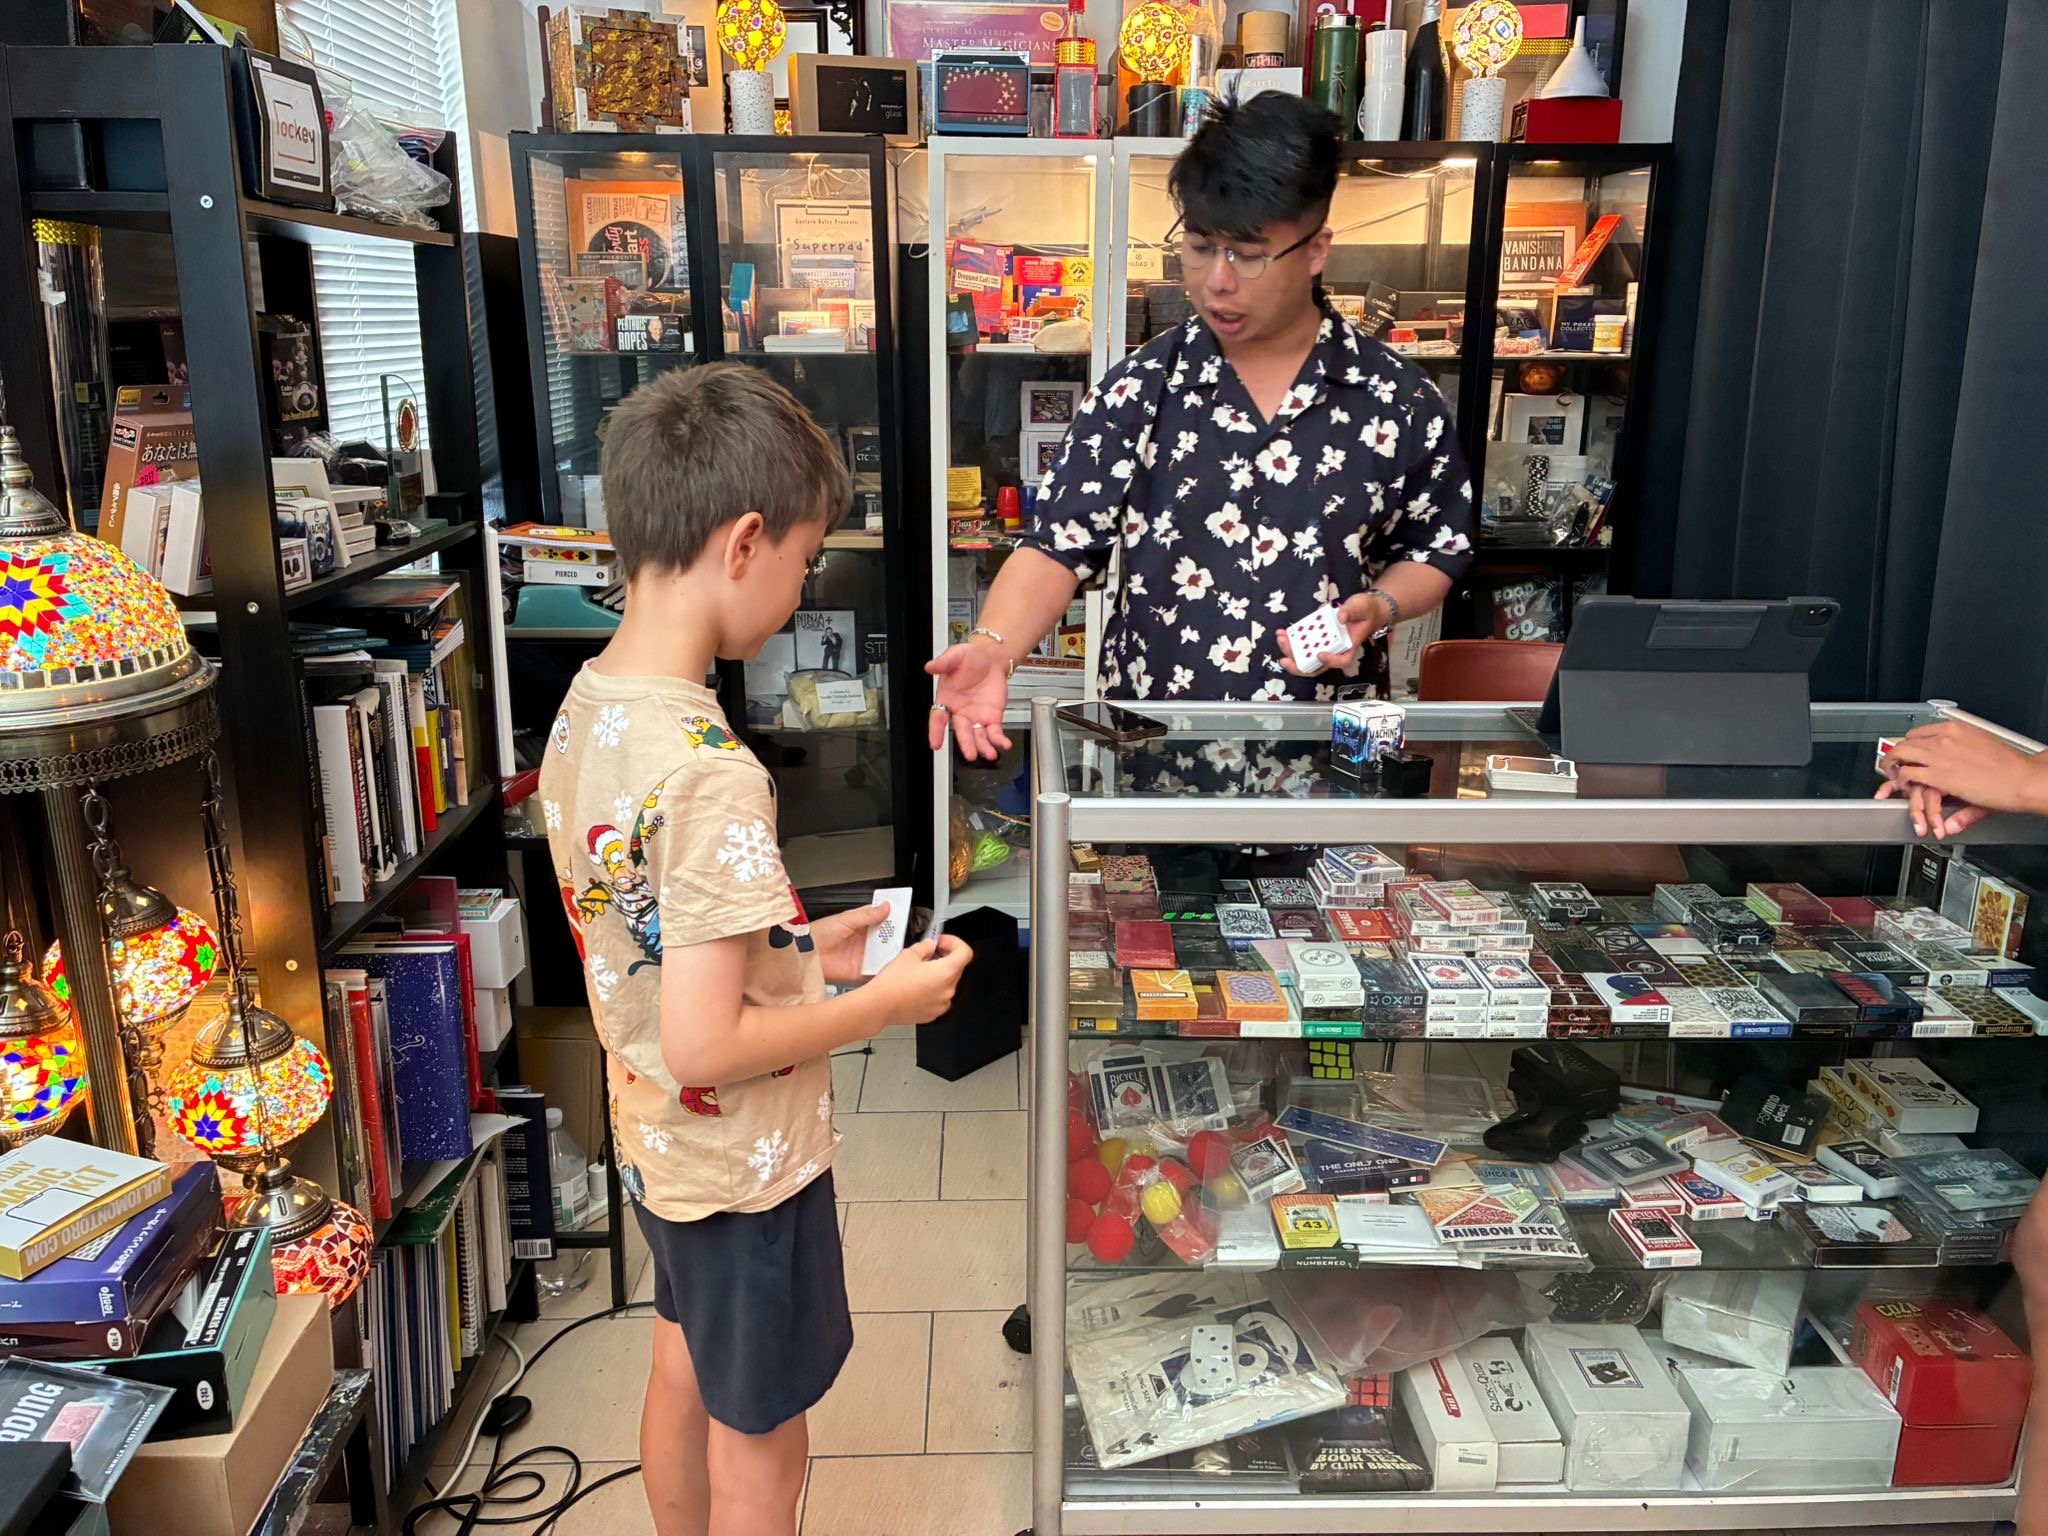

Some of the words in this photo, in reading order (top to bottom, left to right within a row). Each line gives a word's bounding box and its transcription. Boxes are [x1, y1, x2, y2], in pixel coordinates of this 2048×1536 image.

[1504, 240, 1562, 255] VANISHING
[1504, 256, 1562, 271] BANDANA
[618, 331, 648, 351] ROPES
[555, 570, 578, 578] PIERCED
[1506, 619, 1535, 640] GO
[356, 759, 369, 826] HOUDINI
[1261, 879, 1304, 888] BICYCLE
[1110, 1071, 1147, 1088] BICYCLE
[1774, 1103, 1792, 1123] deck
[1319, 1163, 1340, 1171] THE
[1344, 1160, 1373, 1168] ONLY
[1376, 1158, 1400, 1166] ONE
[60, 1164, 119, 1193] KIT
[25, 1175, 167, 1267] JULIOMONTORO.COM
[1622, 1210, 1664, 1220] BICYCLE
[1302, 1221, 1322, 1230] 43
[1442, 1225, 1517, 1239] RAINBOW
[1519, 1225, 1558, 1237] DECK
[98, 1286, 115, 1317] Tenyo
[211, 1297, 230, 1331] SURPRISE
[1315, 1454, 1360, 1462] BOOK
[1362, 1454, 1406, 1462] TEST
[1309, 1462, 1328, 1471] BY
[1330, 1462, 1366, 1471] CLINT
